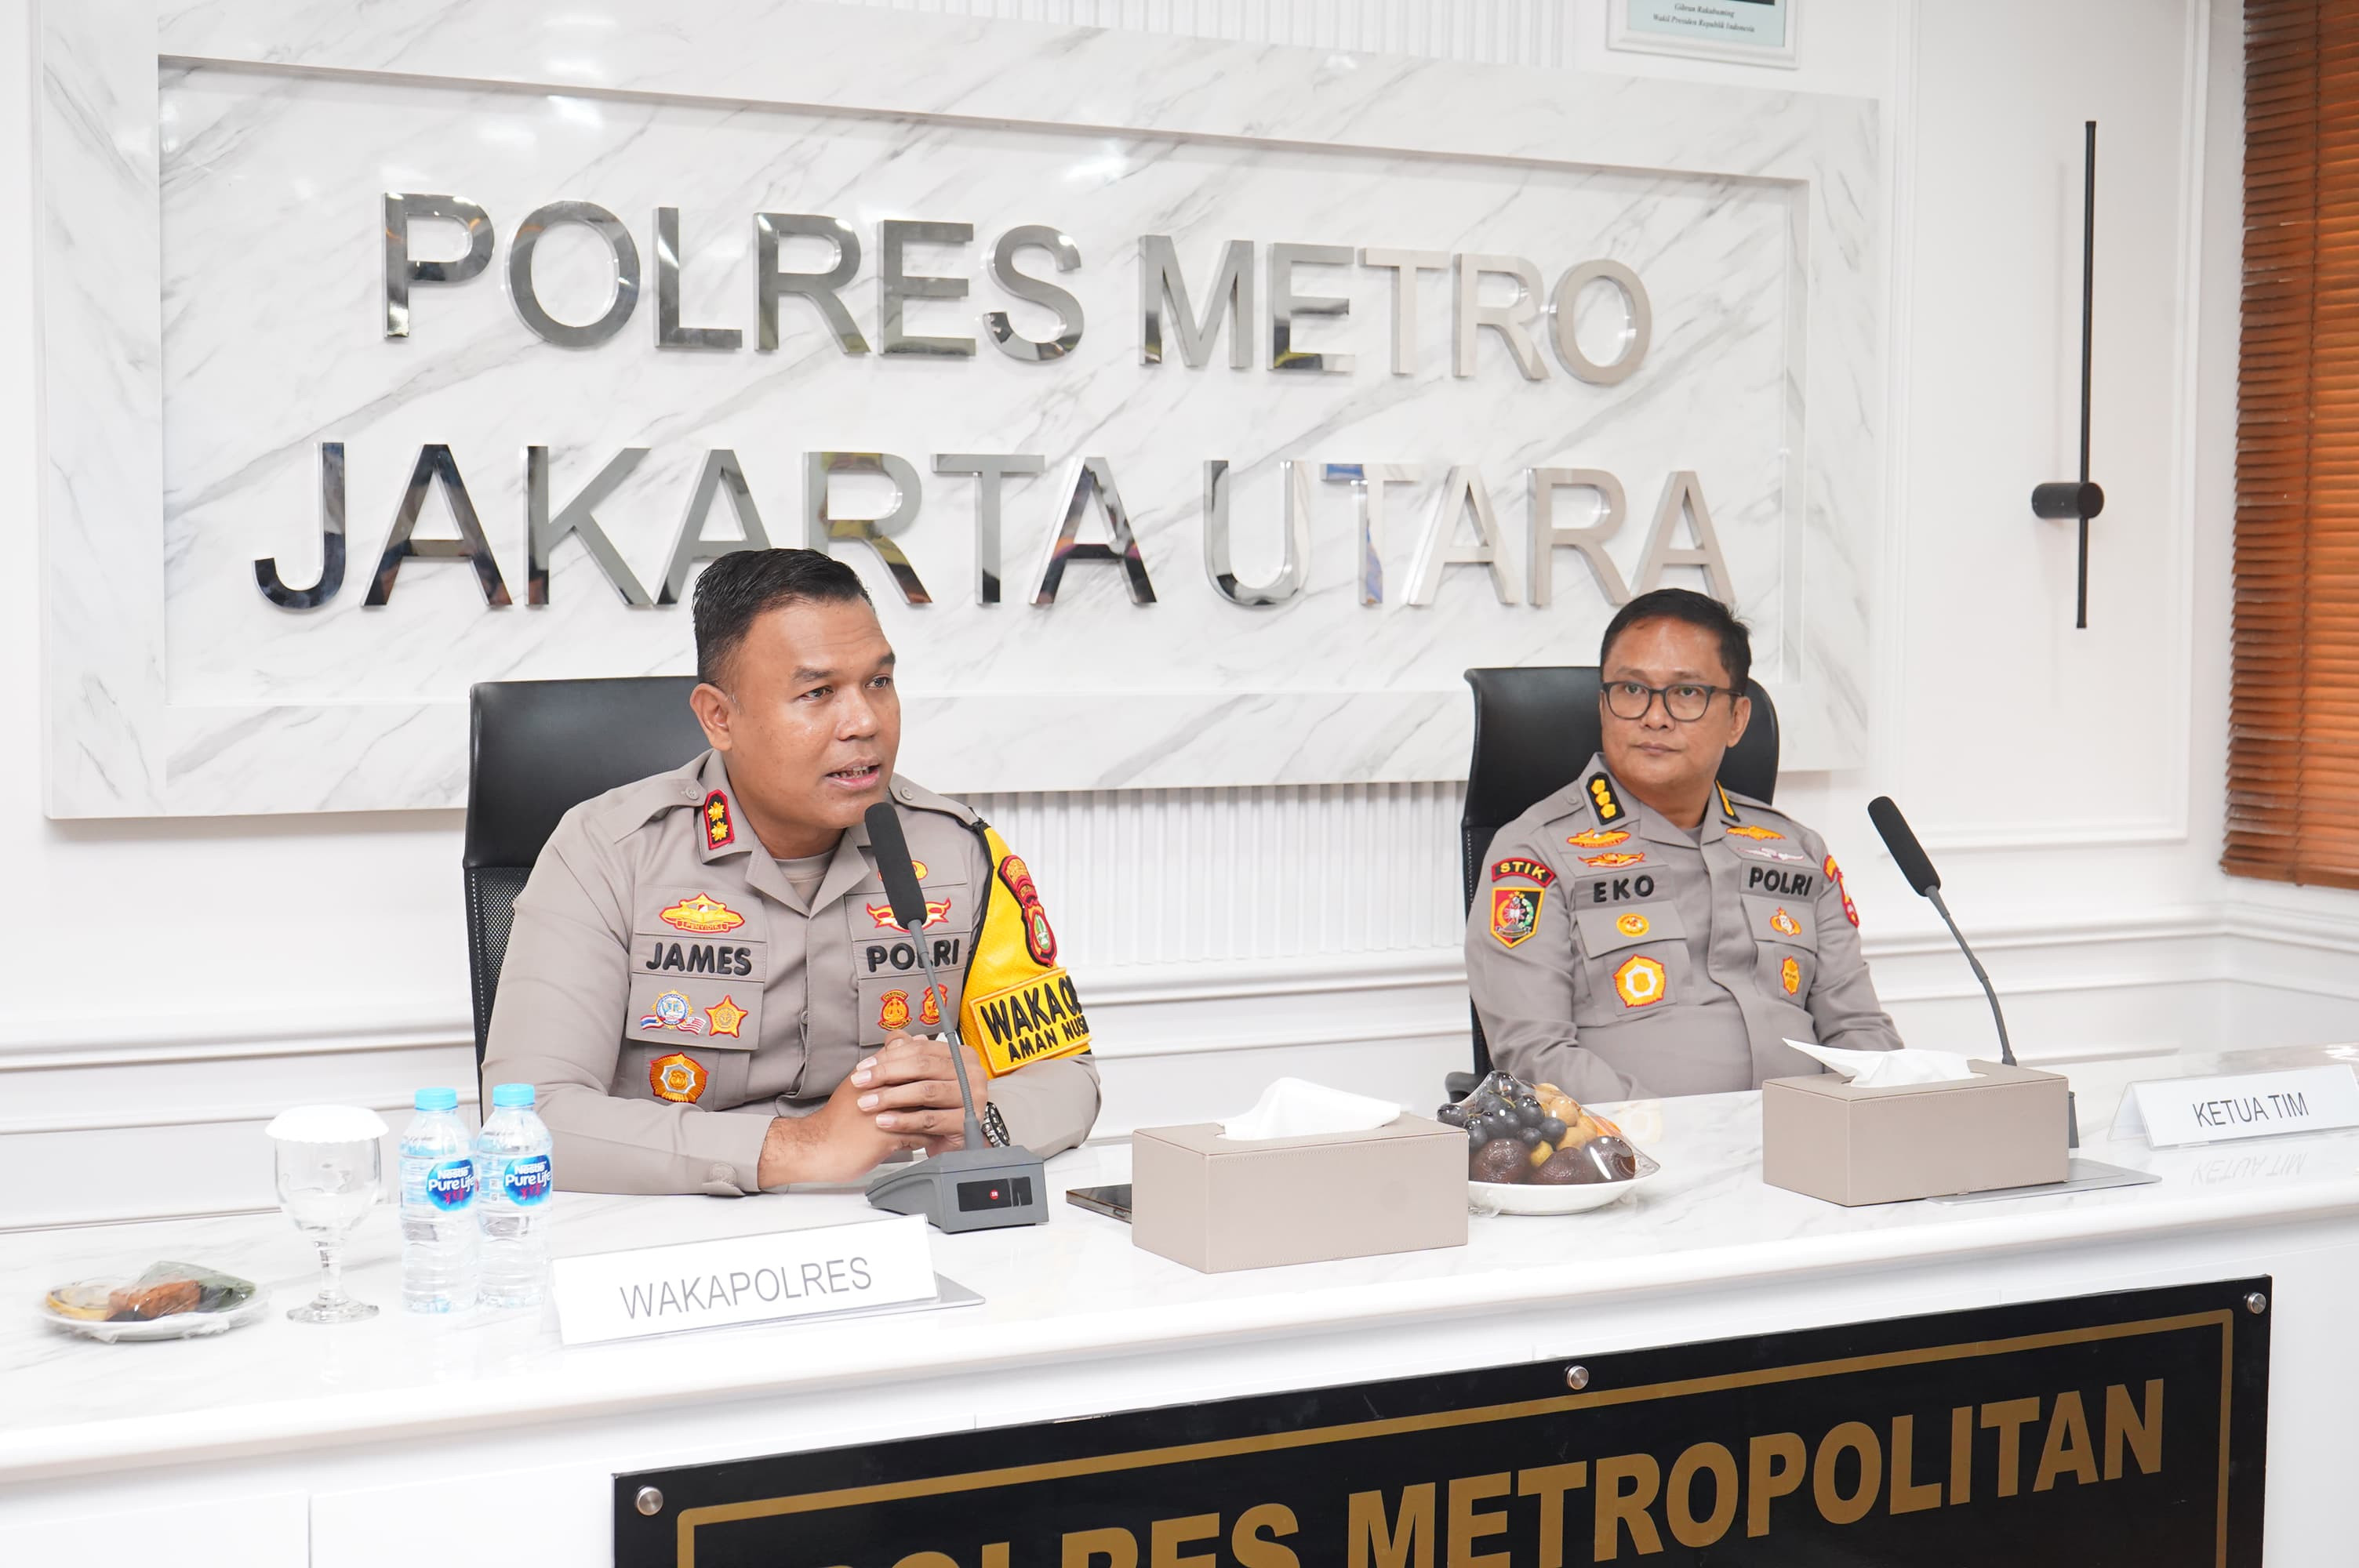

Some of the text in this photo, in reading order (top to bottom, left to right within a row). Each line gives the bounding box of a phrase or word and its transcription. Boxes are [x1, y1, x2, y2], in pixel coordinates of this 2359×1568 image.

[381, 191, 1652, 385] POLRES METRO
[252, 441, 1736, 611] JAKARTA UTARA
[1499, 861, 1547, 880] STIK
[1748, 866, 1813, 898] POLRI
[1592, 874, 1656, 903] EKO
[645, 942, 752, 976] JAMES
[1008, 1027, 1059, 1063] AMAN
[2191, 1092, 2310, 1127] KETUA TIM
[619, 1256, 872, 1320] WAKAPOLRES
[1347, 1377, 2165, 1568] METROPOLITAN
